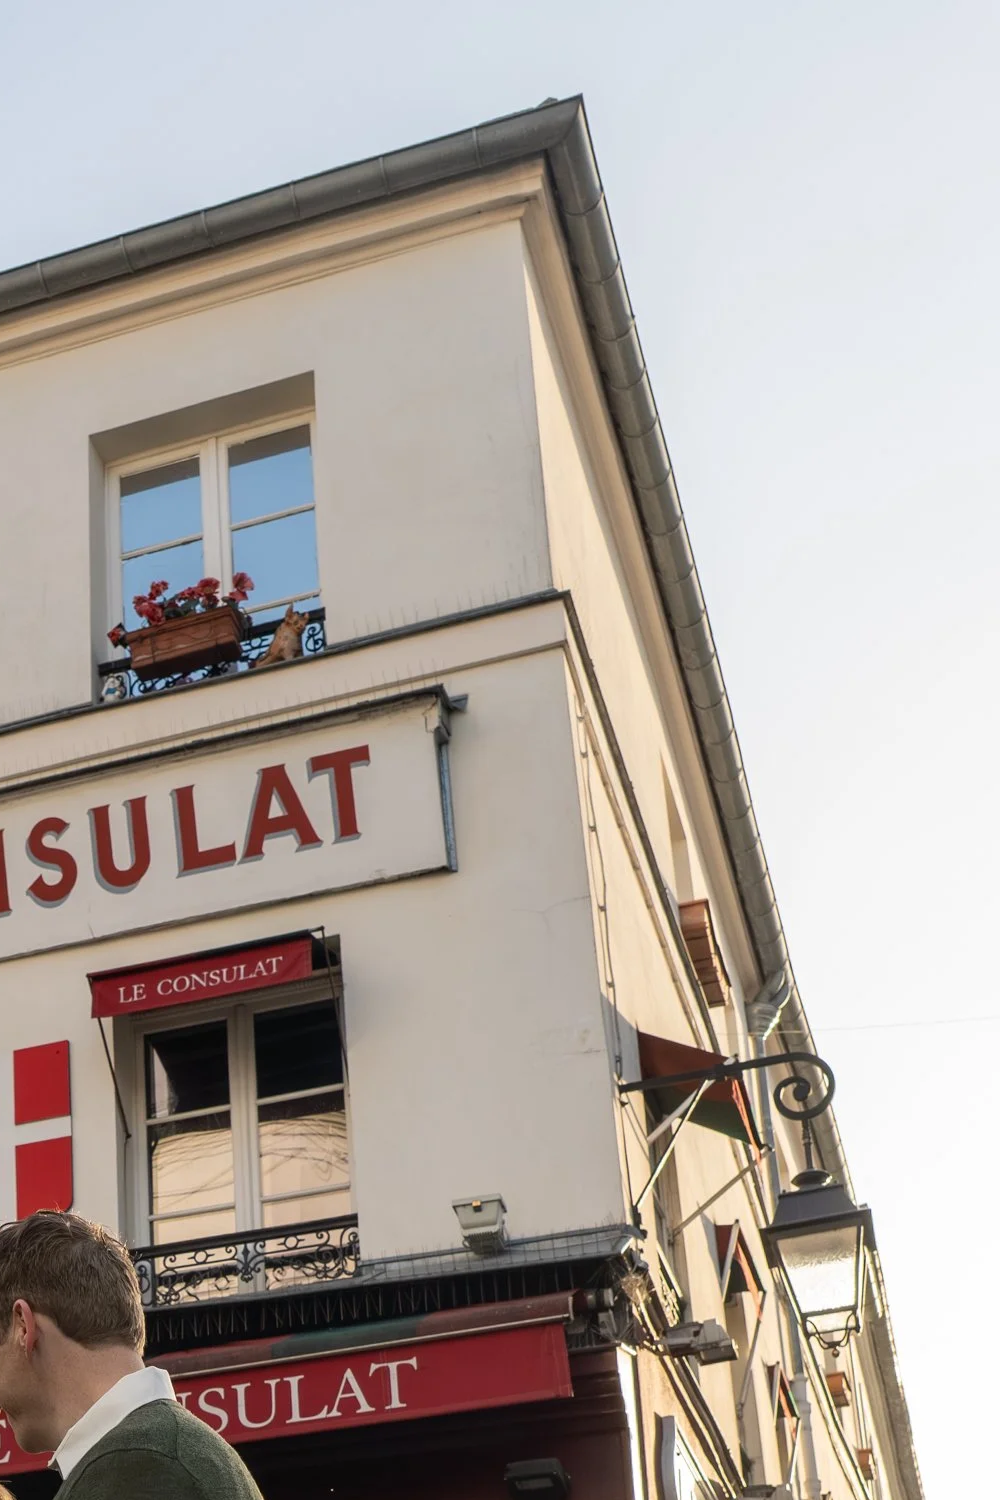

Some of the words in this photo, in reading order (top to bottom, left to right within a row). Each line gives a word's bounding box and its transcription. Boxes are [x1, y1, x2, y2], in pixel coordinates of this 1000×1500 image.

[117, 983, 147, 1005] LE
[155, 954, 285, 997] CONSULAT
[176, 1355, 419, 1434] SULAT
